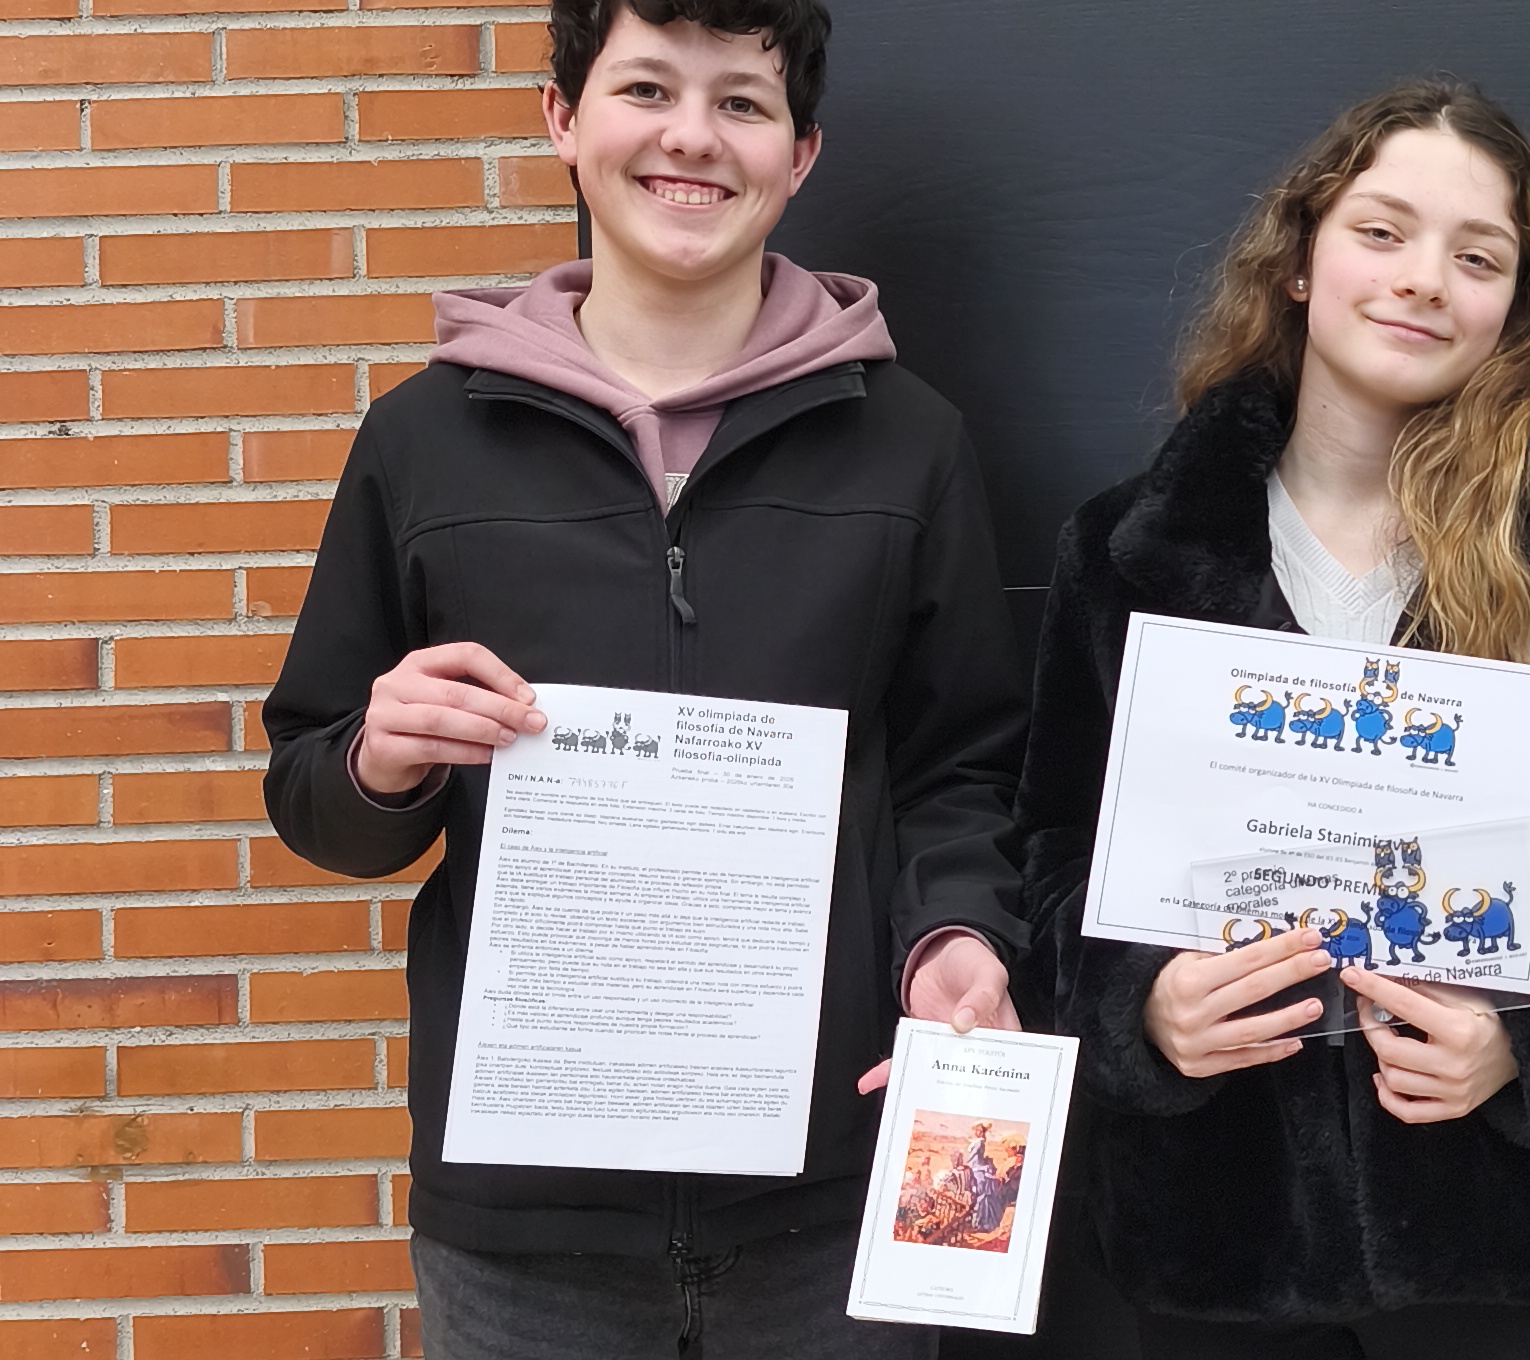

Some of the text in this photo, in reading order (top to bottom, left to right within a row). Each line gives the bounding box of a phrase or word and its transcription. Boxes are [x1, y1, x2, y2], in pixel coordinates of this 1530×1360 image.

[1230, 667, 1463, 708] Olimpiada de filosofía de Navarra
[677, 706, 776, 725] XV olimpiada de
[728, 725, 744, 735] de
[747, 726, 793, 740] Navarra
[675, 734, 763, 751] Nafarroako XV
[1209, 760, 1217, 770] El
[1218, 763, 1246, 774] comité
[1248, 767, 1296, 781] organizador
[1298, 772, 1308, 782] de
[1309, 773, 1318, 783] la
[1319, 775, 1331, 785] XV
[1331, 776, 1373, 792] Olimpiada
[1374, 781, 1385, 792] de
[1420, 787, 1430, 798] de
[1432, 790, 1464, 803] Navarra
[1307, 801, 1364, 815] HA CONCEDIDO A
[502, 826, 533, 836] Dilema:
[1246, 818, 1313, 840] Gabriela
[1223, 870, 1237, 883] 2º
[1253, 867, 1384, 897] SEGUNDO PREMI
[1172, 896, 1180, 905] la
[1424, 972, 1442, 985] de
[1446, 963, 1503, 982] Navarra
[931, 1059, 1030, 1081] Anna Karénina
